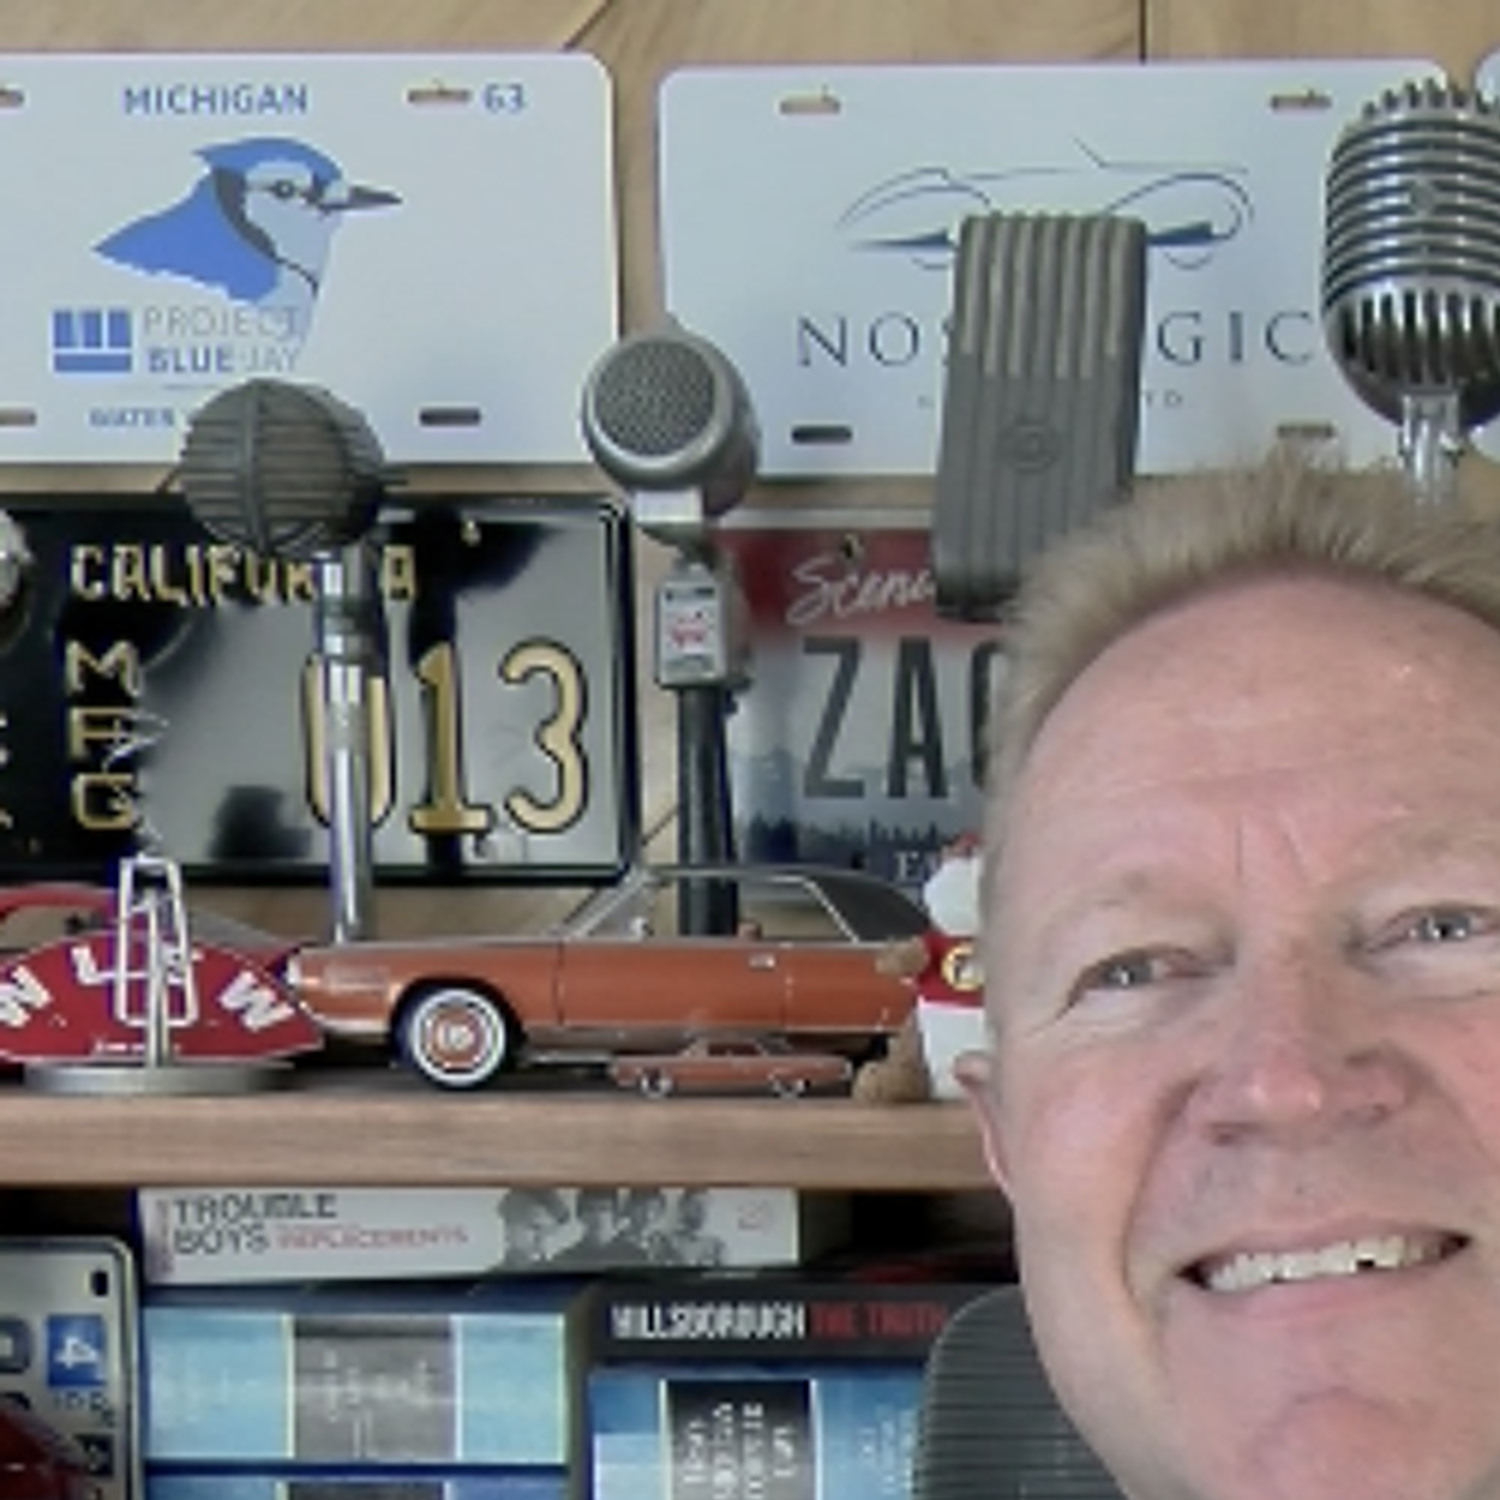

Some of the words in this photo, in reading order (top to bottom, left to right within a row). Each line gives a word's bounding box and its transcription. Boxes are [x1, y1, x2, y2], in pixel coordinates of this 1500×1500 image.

[123, 84, 308, 115] MICHIGAN
[483, 84, 527, 112] 63
[143, 306, 302, 337] PROJECT
[797, 311, 1315, 367] NOGIC
[148, 346, 235, 374] BLUE
[245, 346, 300, 374] JAY
[69, 543, 418, 607] CALIFORA
[785, 553, 936, 628] Scen
[306, 638, 590, 836] 013
[171, 1192, 338, 1225] TROUBLE
[172, 1221, 271, 1256] BOYS
[610, 1302, 806, 1340] HILLSBOROUGH
